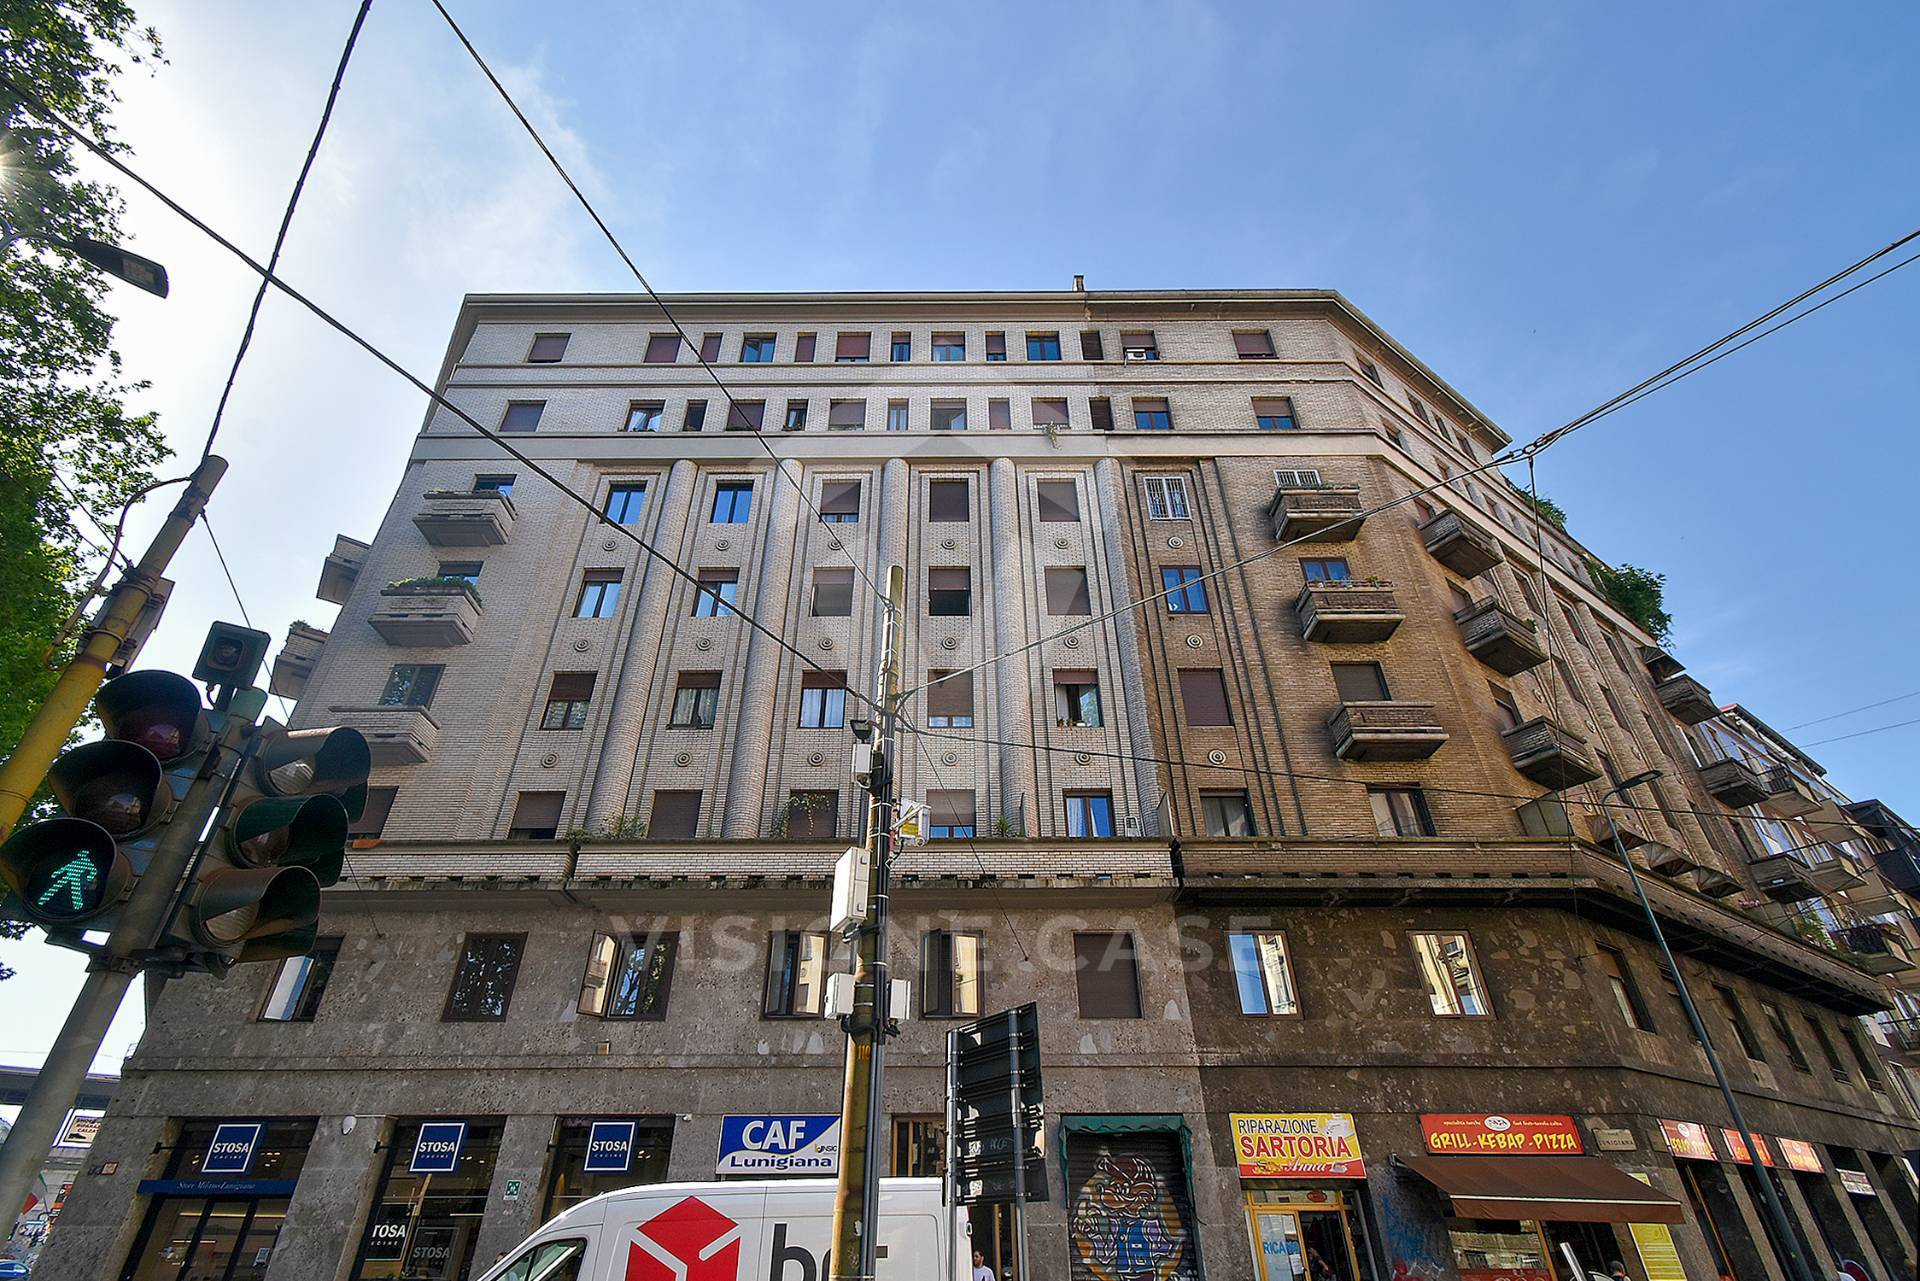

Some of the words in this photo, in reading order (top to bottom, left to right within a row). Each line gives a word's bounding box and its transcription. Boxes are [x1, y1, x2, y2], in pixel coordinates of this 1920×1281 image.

[1238, 1119, 1318, 1134] RIPARAZIONE
[742, 1120, 806, 1150] CAF
[213, 1142, 249, 1153] STOSA
[419, 1141, 455, 1153] STOSA
[591, 1140, 628, 1152] STOSA
[1240, 1136, 1352, 1158] SARTORIA
[730, 1155, 833, 1170] Lunigiana
[413, 1246, 450, 1259] STOSA
